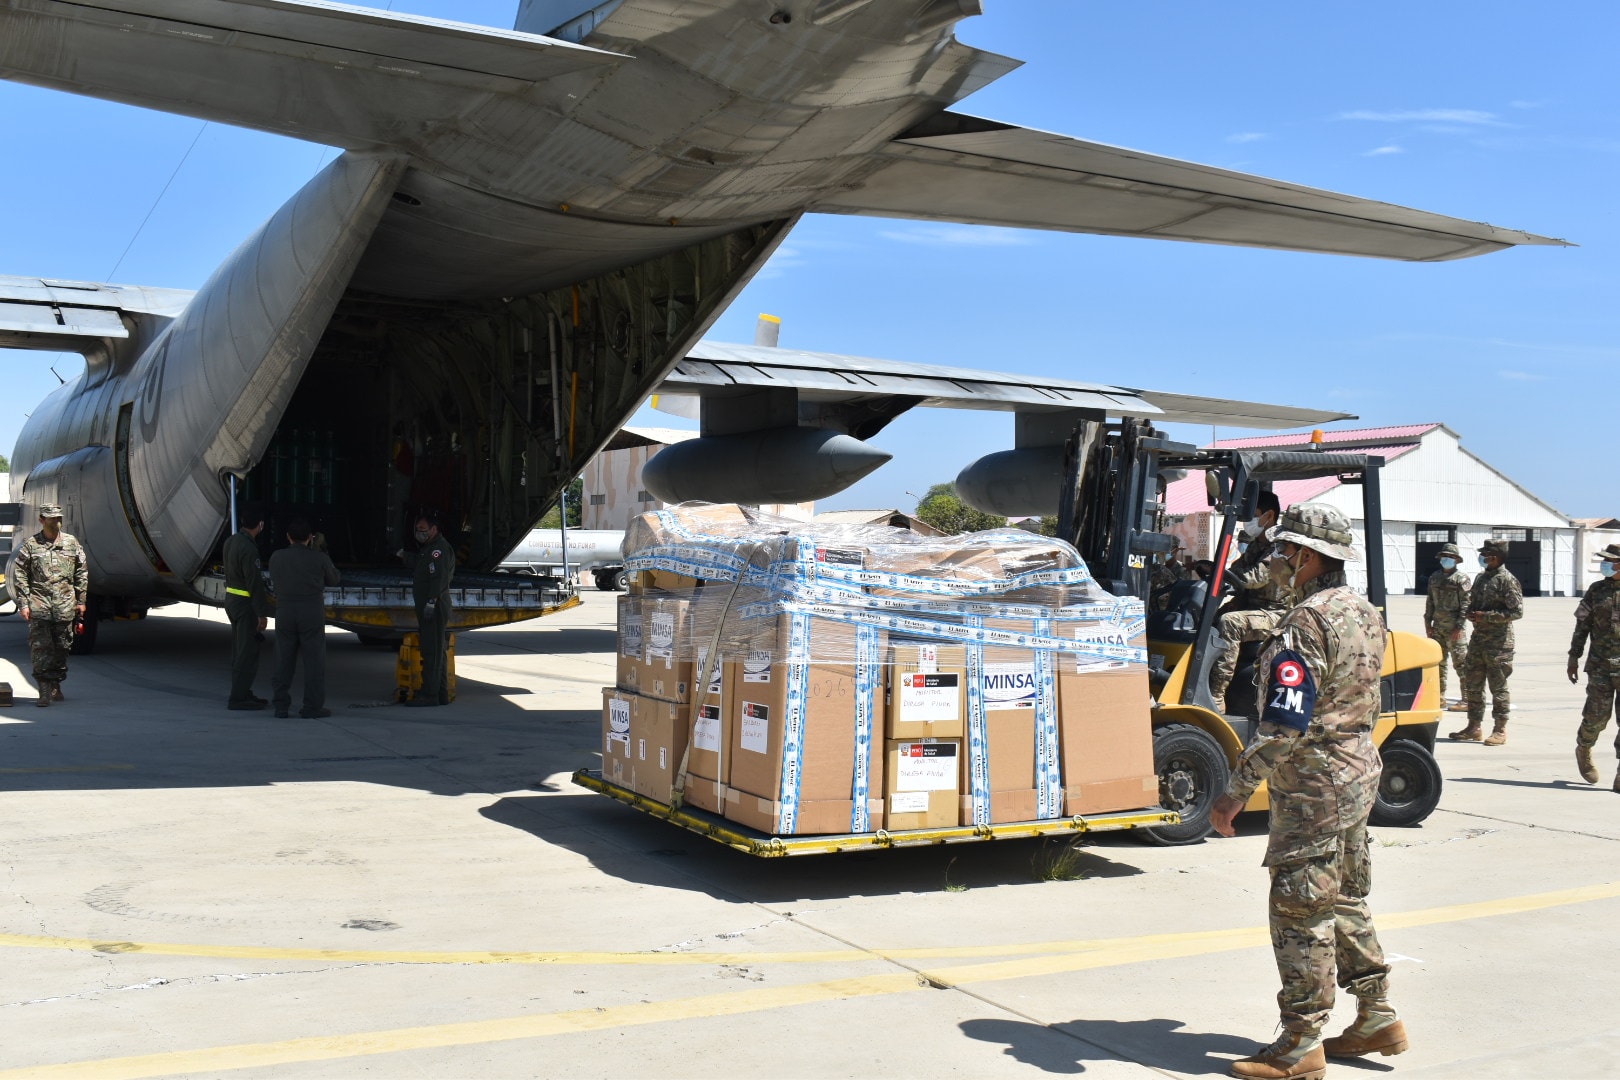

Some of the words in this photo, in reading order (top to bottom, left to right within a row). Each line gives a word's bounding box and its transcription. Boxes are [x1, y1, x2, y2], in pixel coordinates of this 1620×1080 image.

[528, 540, 563, 548] COMBUSTIBL
[1128, 554, 1146, 568] CAT
[652, 622, 672, 638] MINSA
[984, 674, 1035, 690] MINSA
[1270, 687, 1304, 714] Z.M.
[612, 708, 629, 724] MNSA
